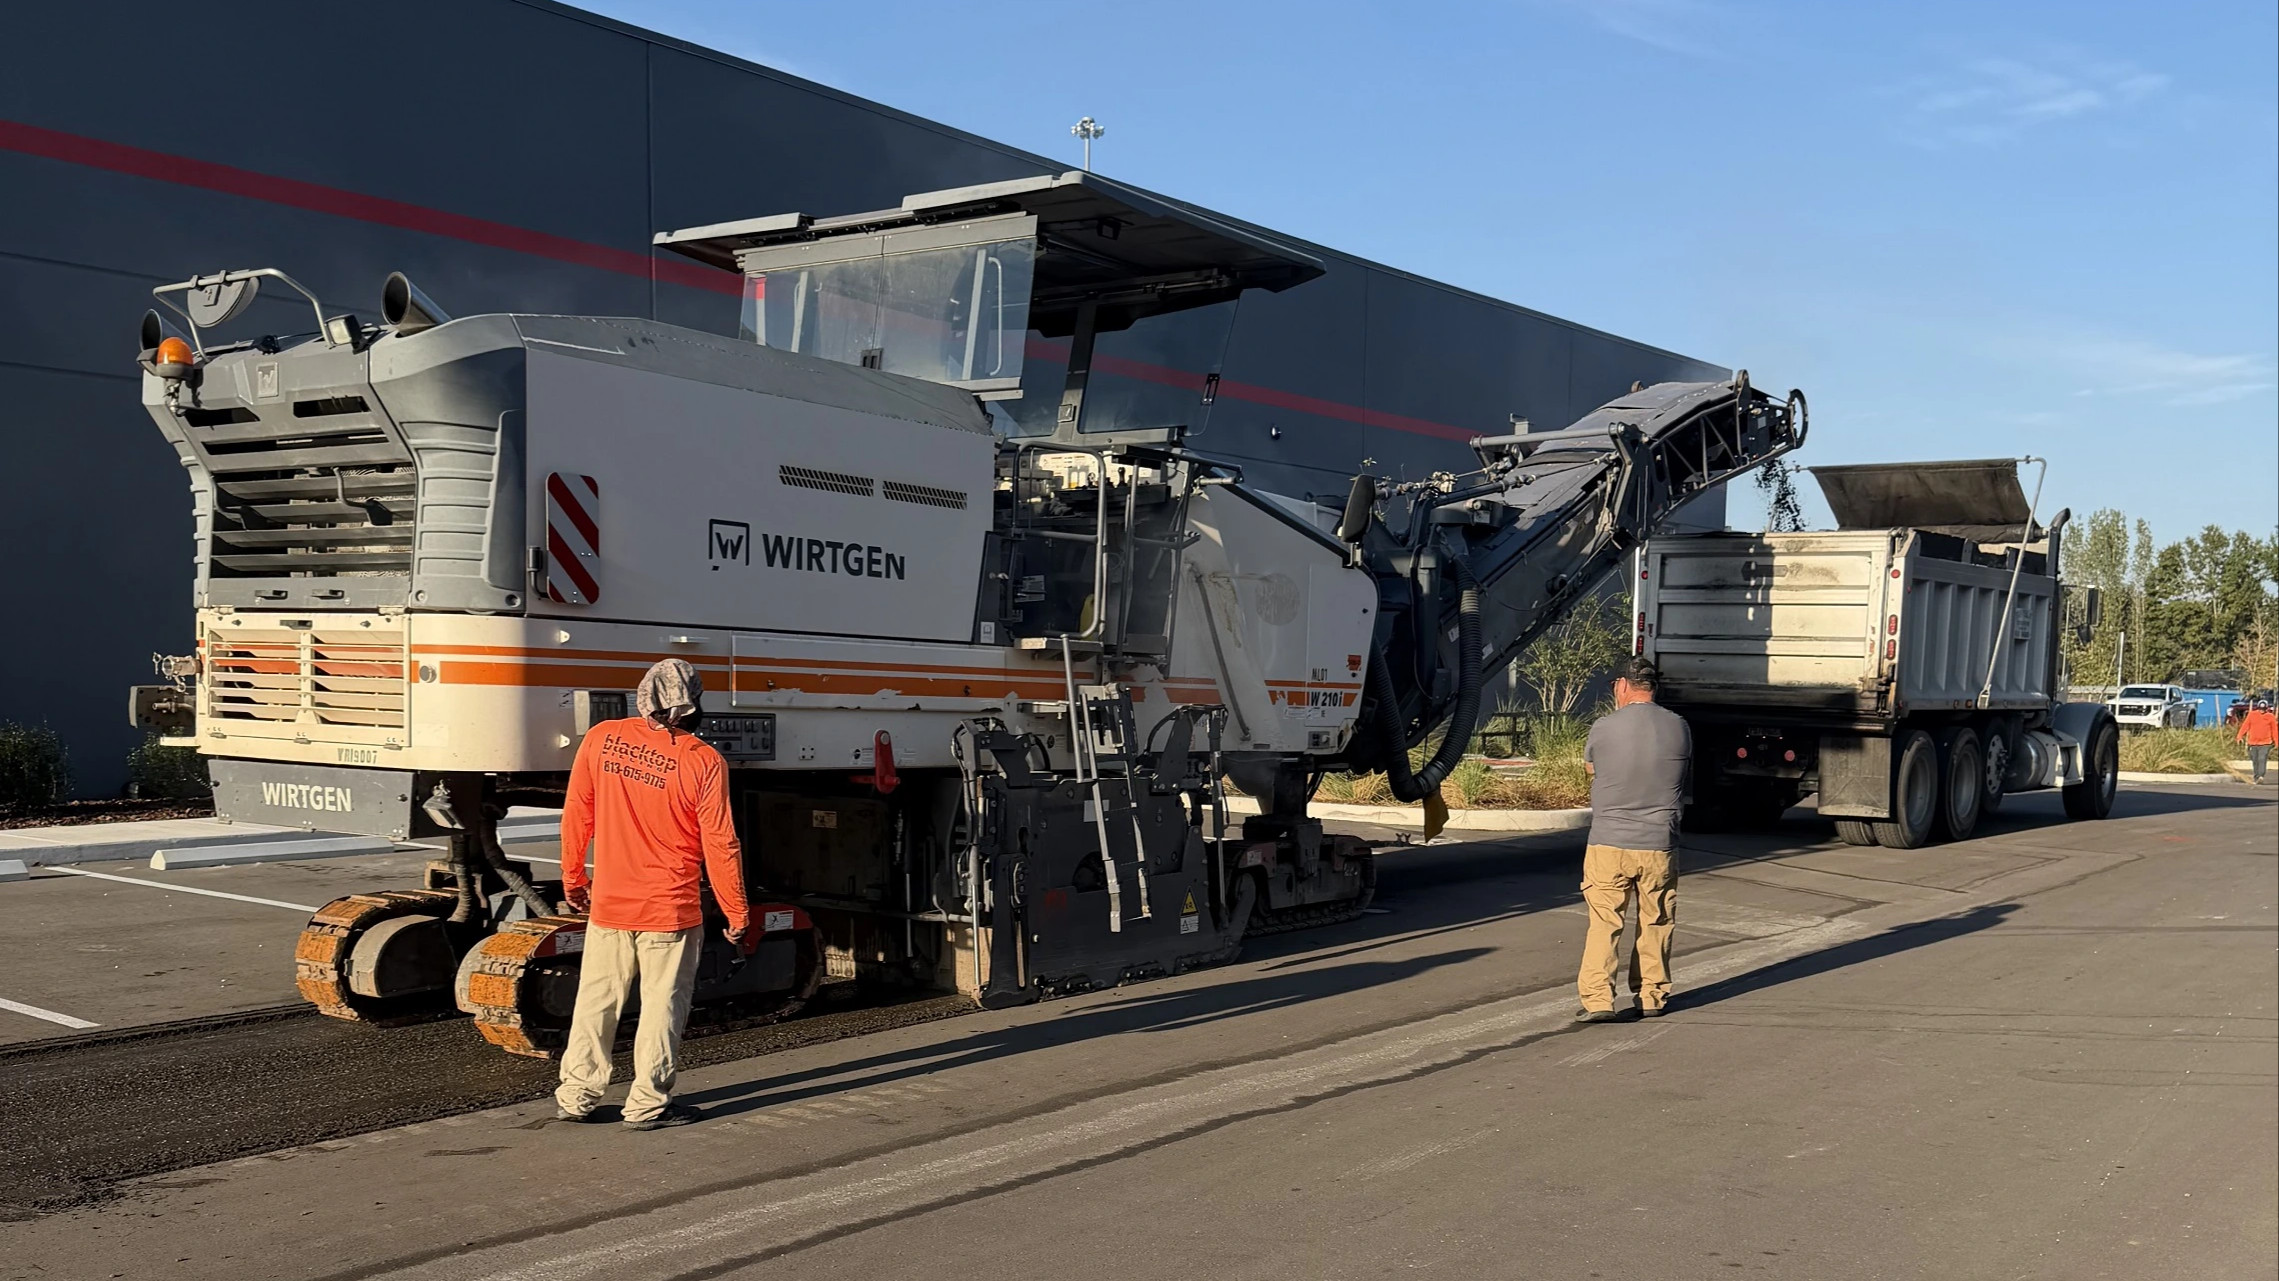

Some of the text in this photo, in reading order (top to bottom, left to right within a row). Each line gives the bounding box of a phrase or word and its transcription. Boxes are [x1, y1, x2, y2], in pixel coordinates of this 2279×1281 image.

[762, 533, 905, 581] WIRTGEN
[1310, 691, 1343, 707] W 210i
[603, 733, 677, 774] blacktop
[603, 760, 667, 789] 813-675-9775
[262, 781, 352, 812] WIRTGEN
